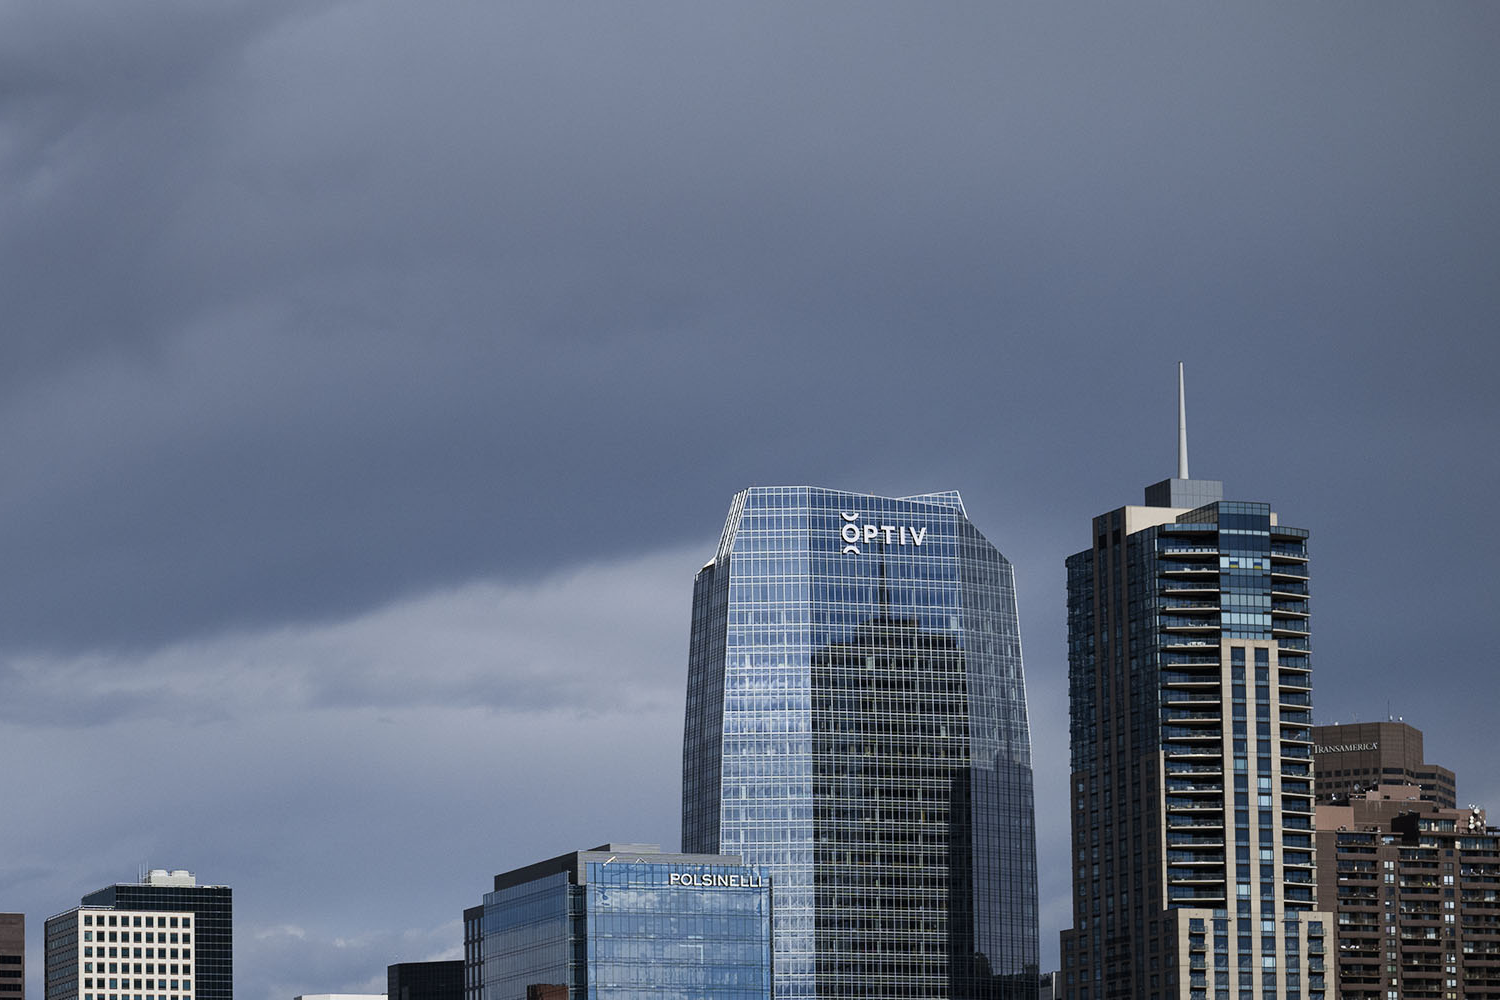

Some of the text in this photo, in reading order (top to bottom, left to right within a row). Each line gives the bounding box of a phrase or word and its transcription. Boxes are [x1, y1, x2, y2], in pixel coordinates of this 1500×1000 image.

[841, 516, 927, 551] OPTIV
[1313, 742, 1378, 754] TRANSAMERICA
[670, 873, 762, 888] POLSINELLI
